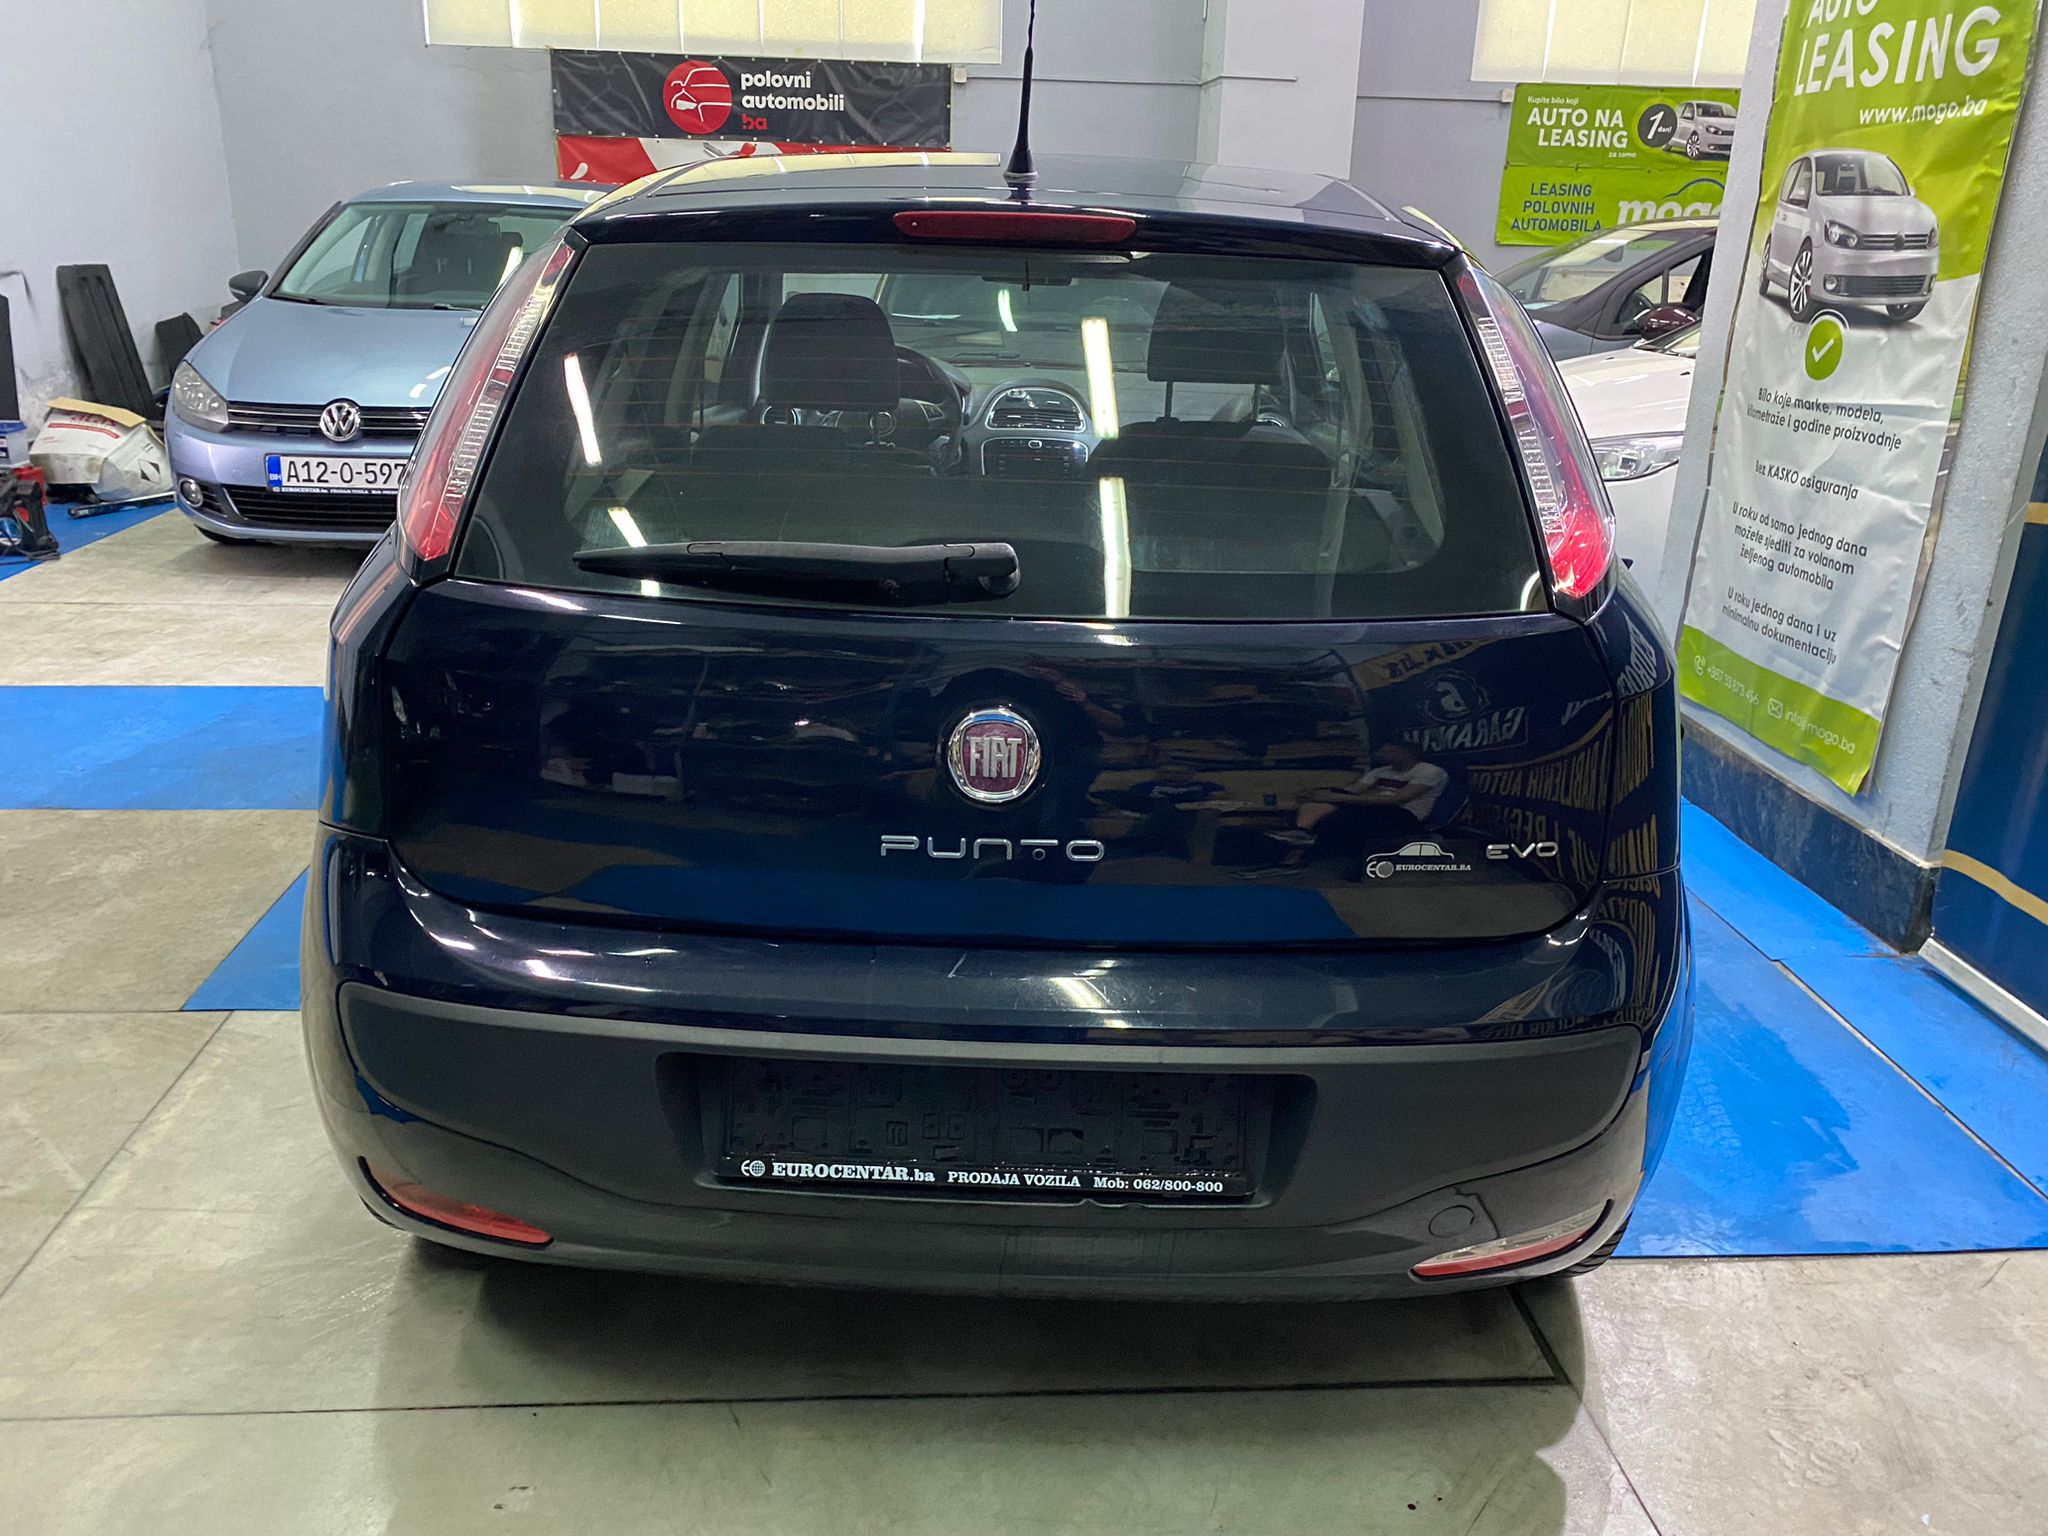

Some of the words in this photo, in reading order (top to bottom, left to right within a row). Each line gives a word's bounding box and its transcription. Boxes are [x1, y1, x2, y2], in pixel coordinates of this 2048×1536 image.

[1794, 5, 2002, 97] LEASING
[740, 70, 811, 90] polovni
[741, 93, 844, 111] automobili
[1527, 95, 1550, 105] Kupite
[1551, 96, 1565, 104] bilo
[1565, 97, 1579, 105] koji
[1859, 95, 1988, 126] www.mogo.ba
[1527, 107, 1588, 127] AUTO
[1595, 109, 1624, 128] NA
[1647, 111, 1664, 139] 1
[1538, 129, 1628, 149] LEASING
[1530, 183, 1592, 197] LEASING
[1523, 200, 1595, 215] POLOVNIH
[1617, 199, 1722, 225] mo
[1511, 218, 1601, 232] AUTOMOBILA
[1773, 392, 1791, 409] koje
[1793, 397, 1833, 416] marke,
[1835, 404, 1884, 424] modela,
[1793, 416, 1831, 435] godine
[1833, 425, 1901, 451] proizvodnje
[1767, 464, 1799, 484] KASKO
[1800, 474, 1859, 501] osiguranja
[1738, 505, 1758, 521] roku
[1759, 513, 1769, 526] od
[1770, 518, 1795, 535] samo
[1797, 523, 1834, 549] jednog
[1836, 537, 1867, 557] dana
[1764, 533, 1792, 554] sjediti
[1794, 546, 1805, 558] za
[1808, 550, 1854, 575] volanom
[1777, 561, 1834, 590] automobila
[1750, 598, 1785, 625] jednog
[1786, 614, 1813, 632] dana
[1823, 628, 1838, 642] uz
[1761, 623, 1837, 665] dokumentaciju
[968, 735, 1023, 778] FIAT
[880, 834, 1105, 862] PUNTO
[1486, 841, 1559, 860] EVO
[1395, 864, 1472, 872] EUROCENTAR.BA
[772, 1162, 935, 1182] EUROCENTAR.ba
[947, 1171, 1020, 1185] PRODAJA
[1025, 1174, 1081, 1187] VOZILA
[1093, 1176, 1130, 1189] Mob:
[1133, 1178, 1223, 1193] 062/800-800
